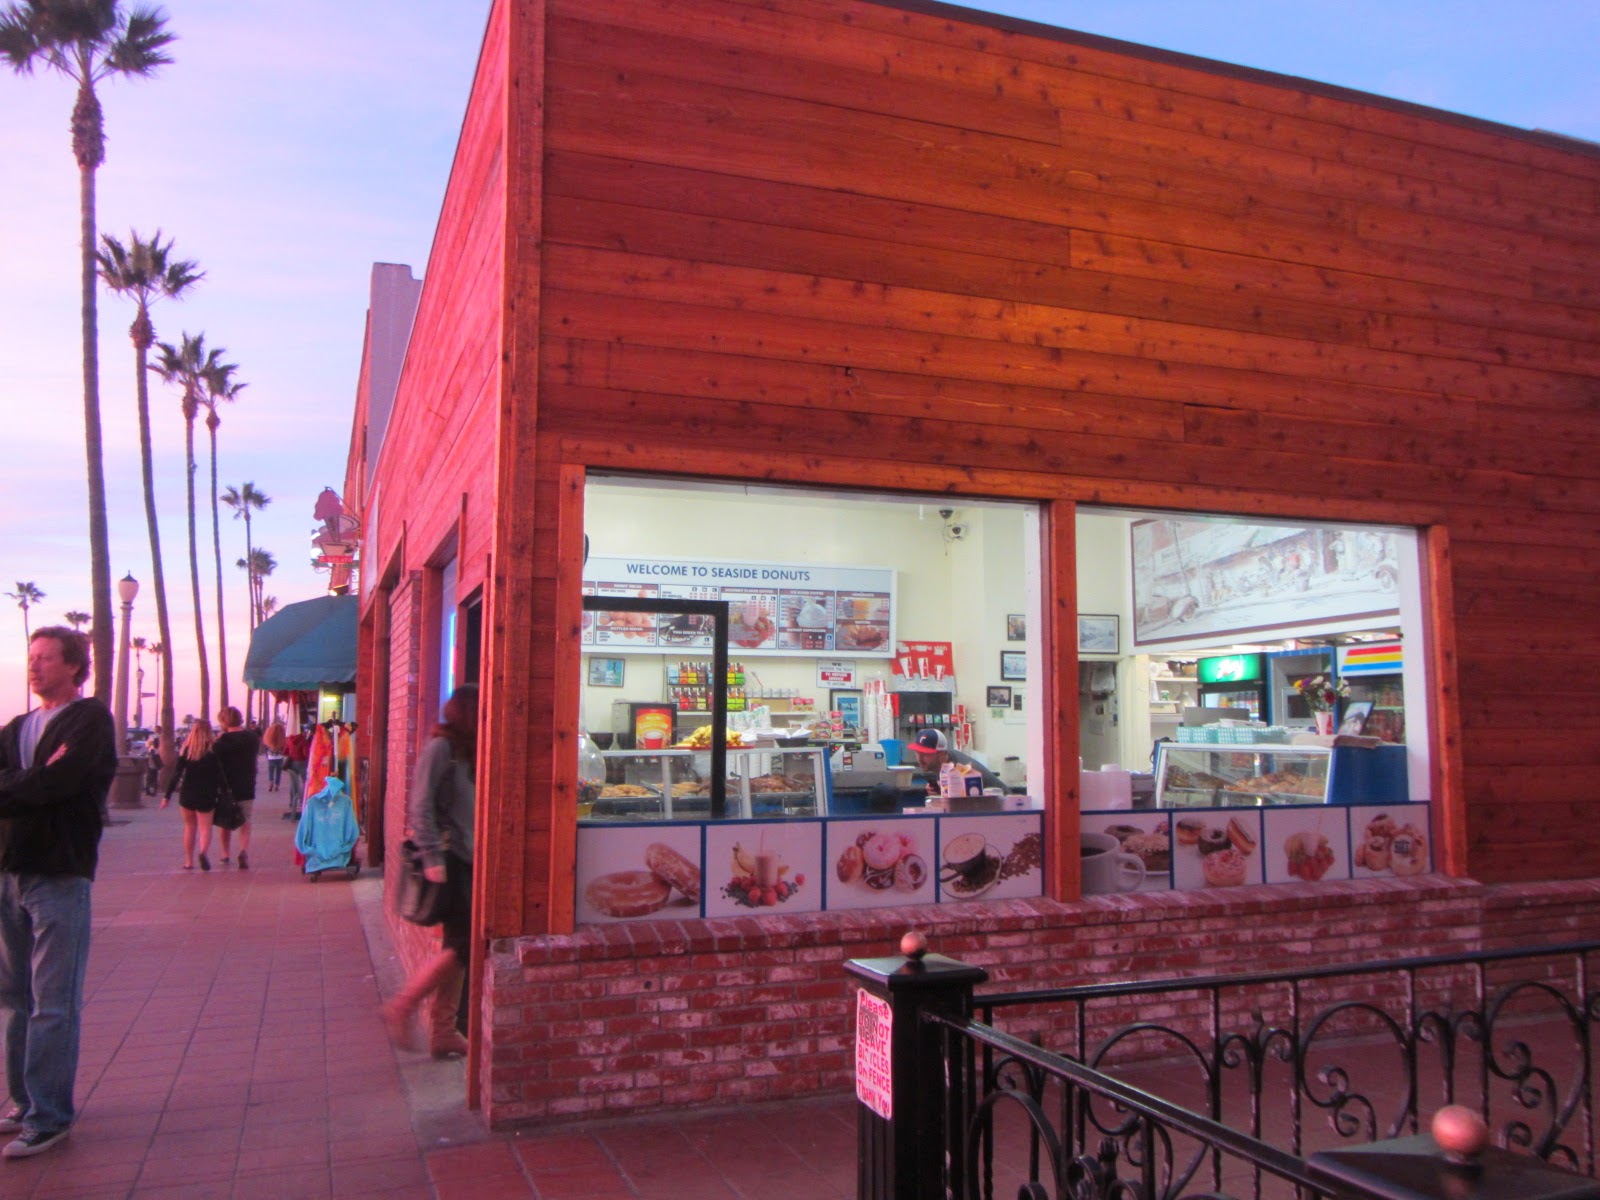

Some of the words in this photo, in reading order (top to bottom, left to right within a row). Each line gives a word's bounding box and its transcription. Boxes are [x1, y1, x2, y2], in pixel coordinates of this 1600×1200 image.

[626, 564, 688, 576] WELCOME
[692, 566, 708, 577] TO
[711, 567, 758, 579] SEASIDE
[761, 569, 810, 581] DONUTS
[860, 991, 889, 1020] Please
[858, 1011, 870, 1029] DO
[872, 1019, 890, 1041] NOT
[859, 1029, 887, 1057] LEAVE
[868, 1068, 890, 1094] FENCE
[857, 1079, 876, 1102] Thank
[877, 1093, 890, 1114] You
